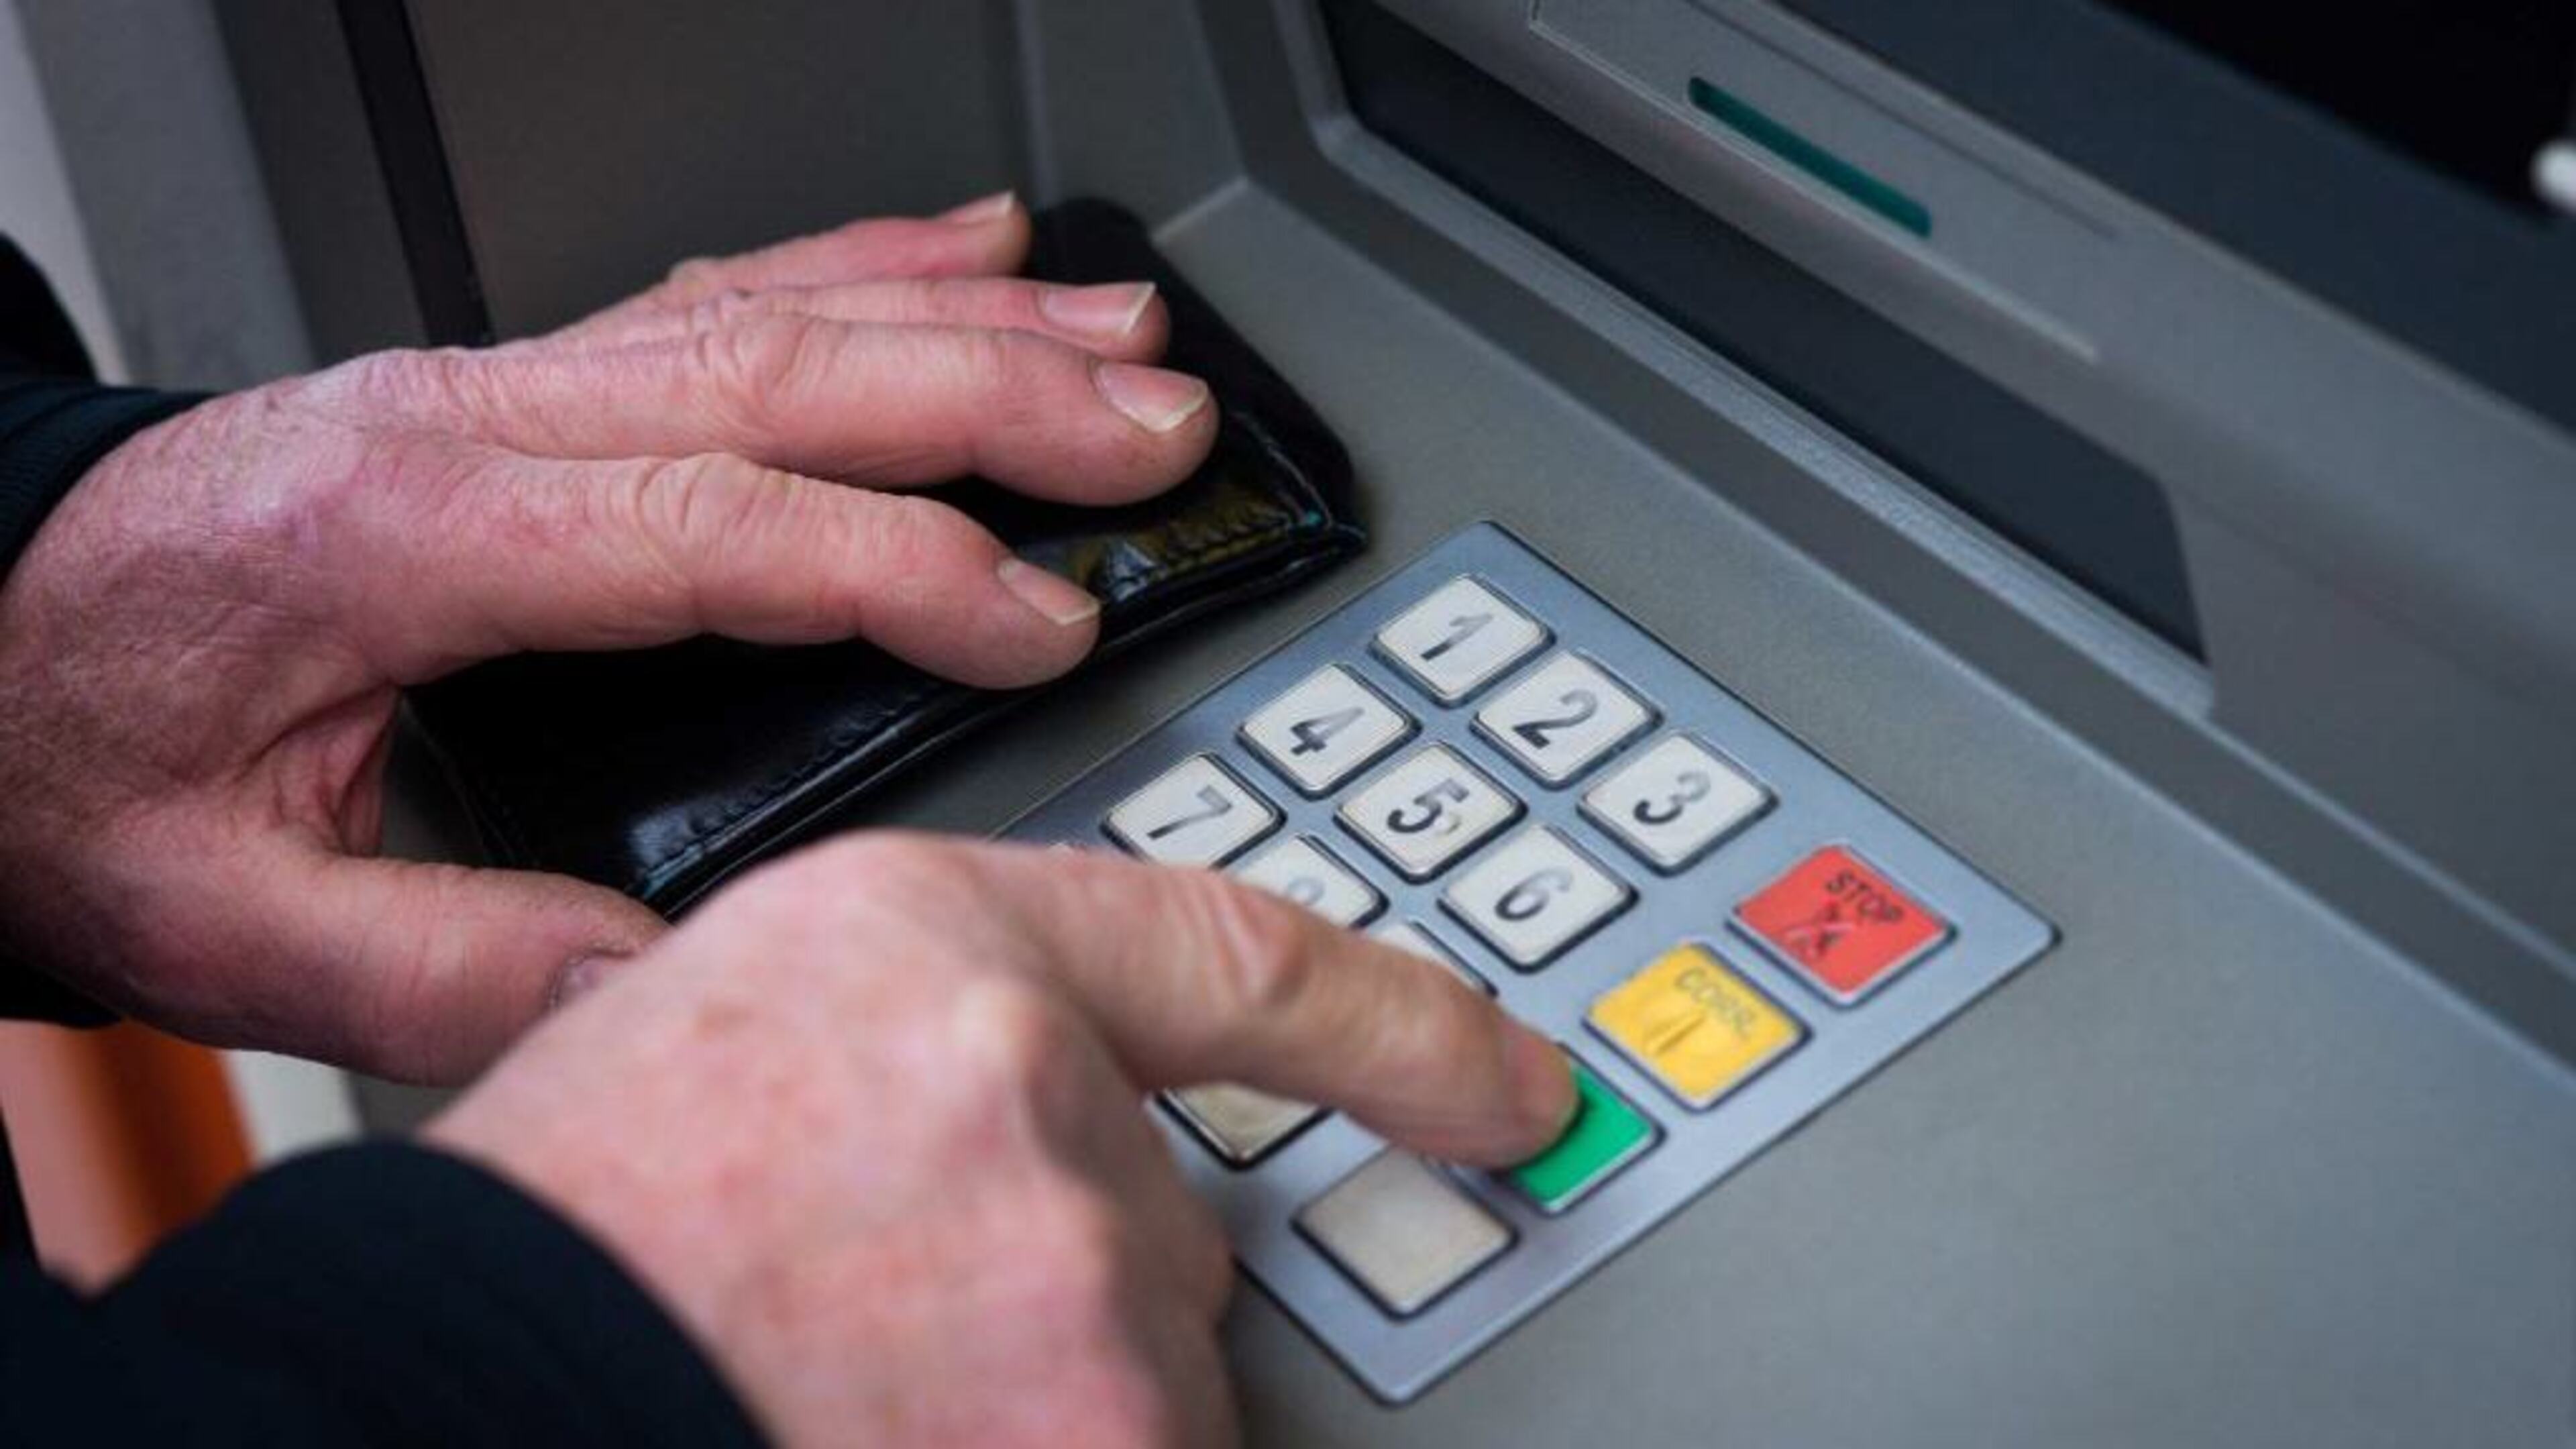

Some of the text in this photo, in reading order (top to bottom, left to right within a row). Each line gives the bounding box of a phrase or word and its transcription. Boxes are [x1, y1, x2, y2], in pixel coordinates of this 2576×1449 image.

[1420, 613, 1493, 661] 1
[1291, 706, 1364, 755] 4
[1513, 690, 1598, 749] 2
[1147, 784, 1233, 841] 7
[1387, 777, 1469, 833] 5
[1633, 771, 1711, 825] 3
[1494, 867, 1573, 920] 6
[1825, 871, 1903, 924] STOP
